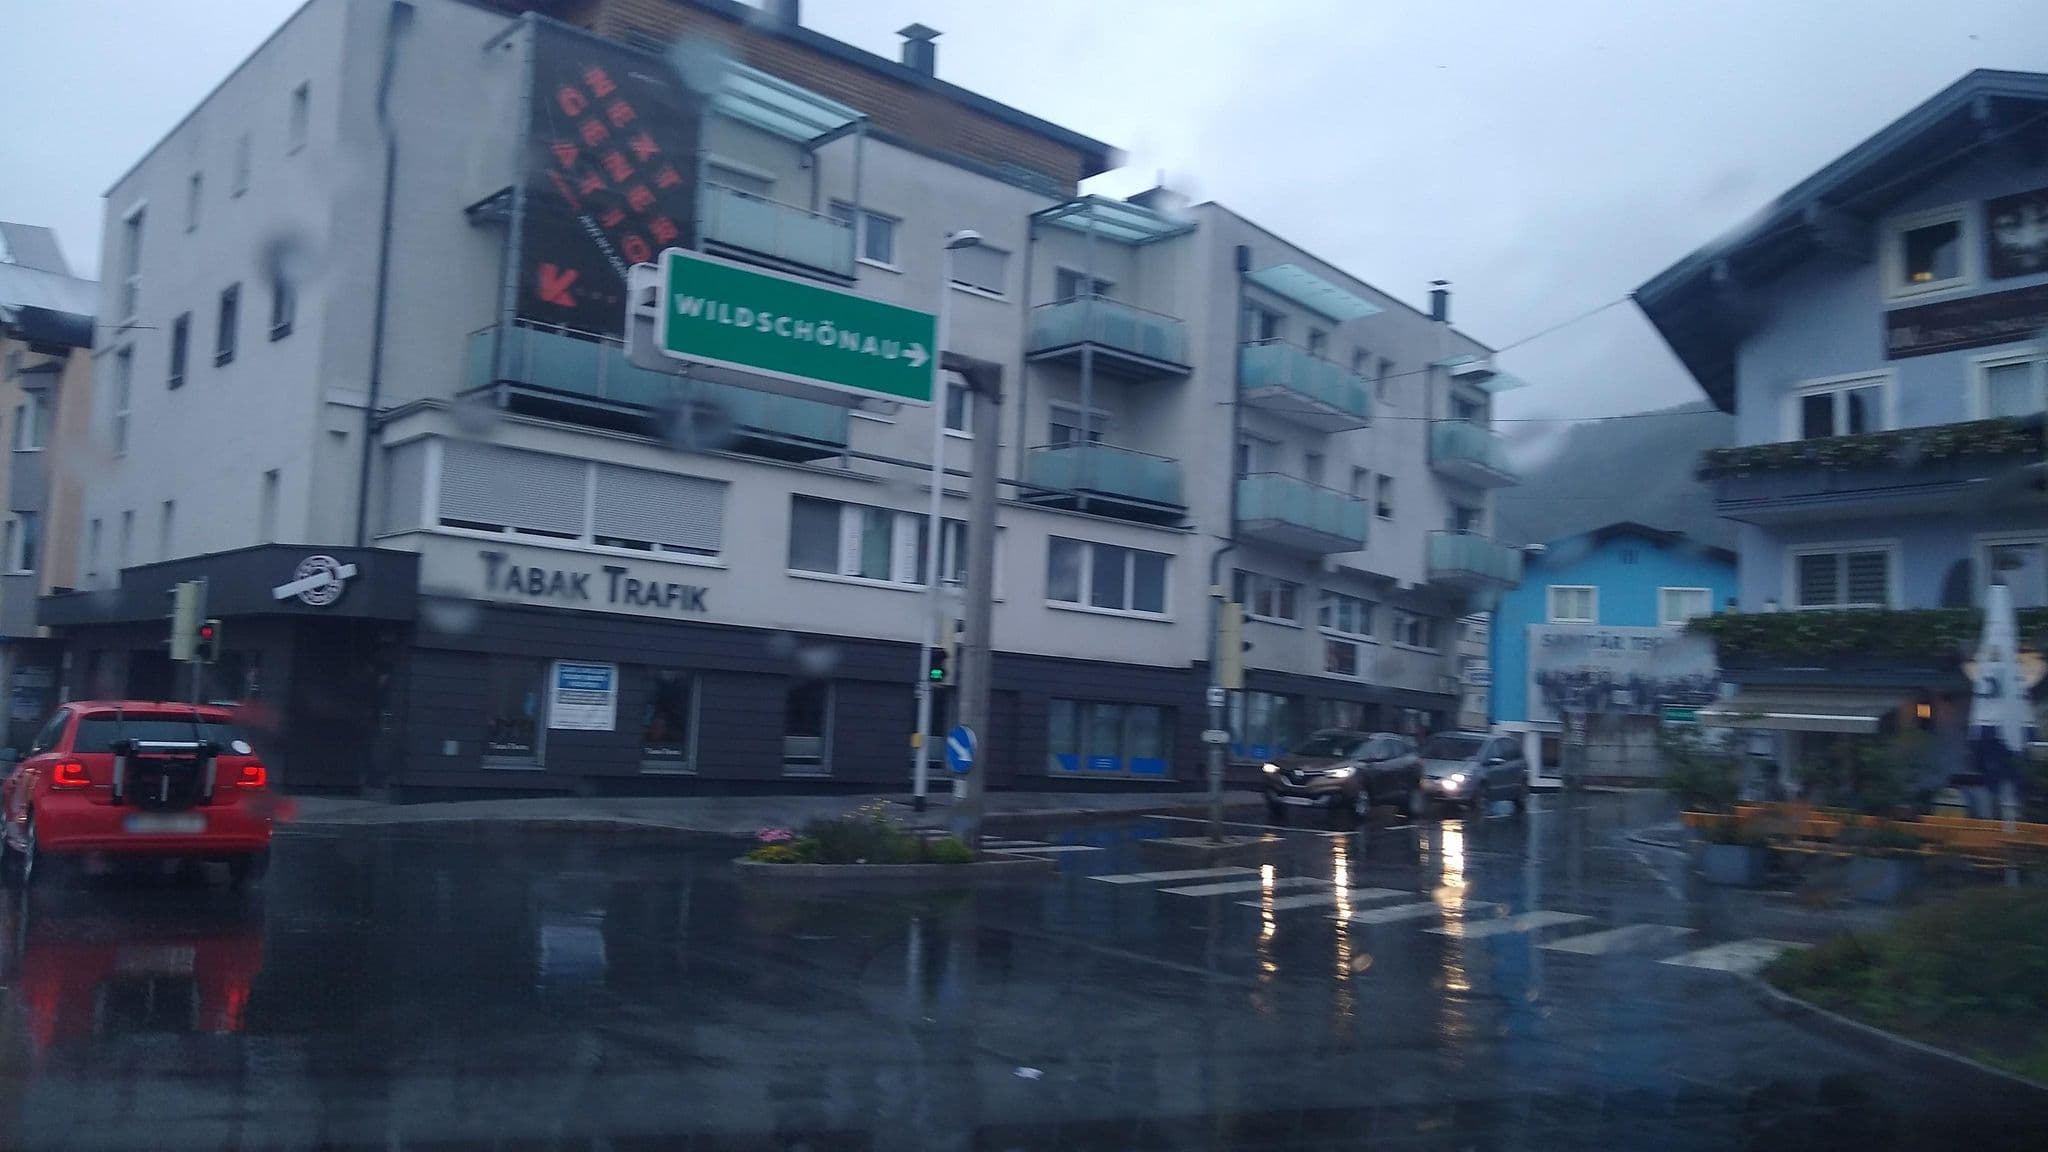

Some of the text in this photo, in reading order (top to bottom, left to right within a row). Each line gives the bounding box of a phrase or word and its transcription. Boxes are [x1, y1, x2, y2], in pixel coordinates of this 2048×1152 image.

[674, 294, 900, 359] WILDSCHÖNAU
[482, 552, 709, 612] TABAK TRAFIK
